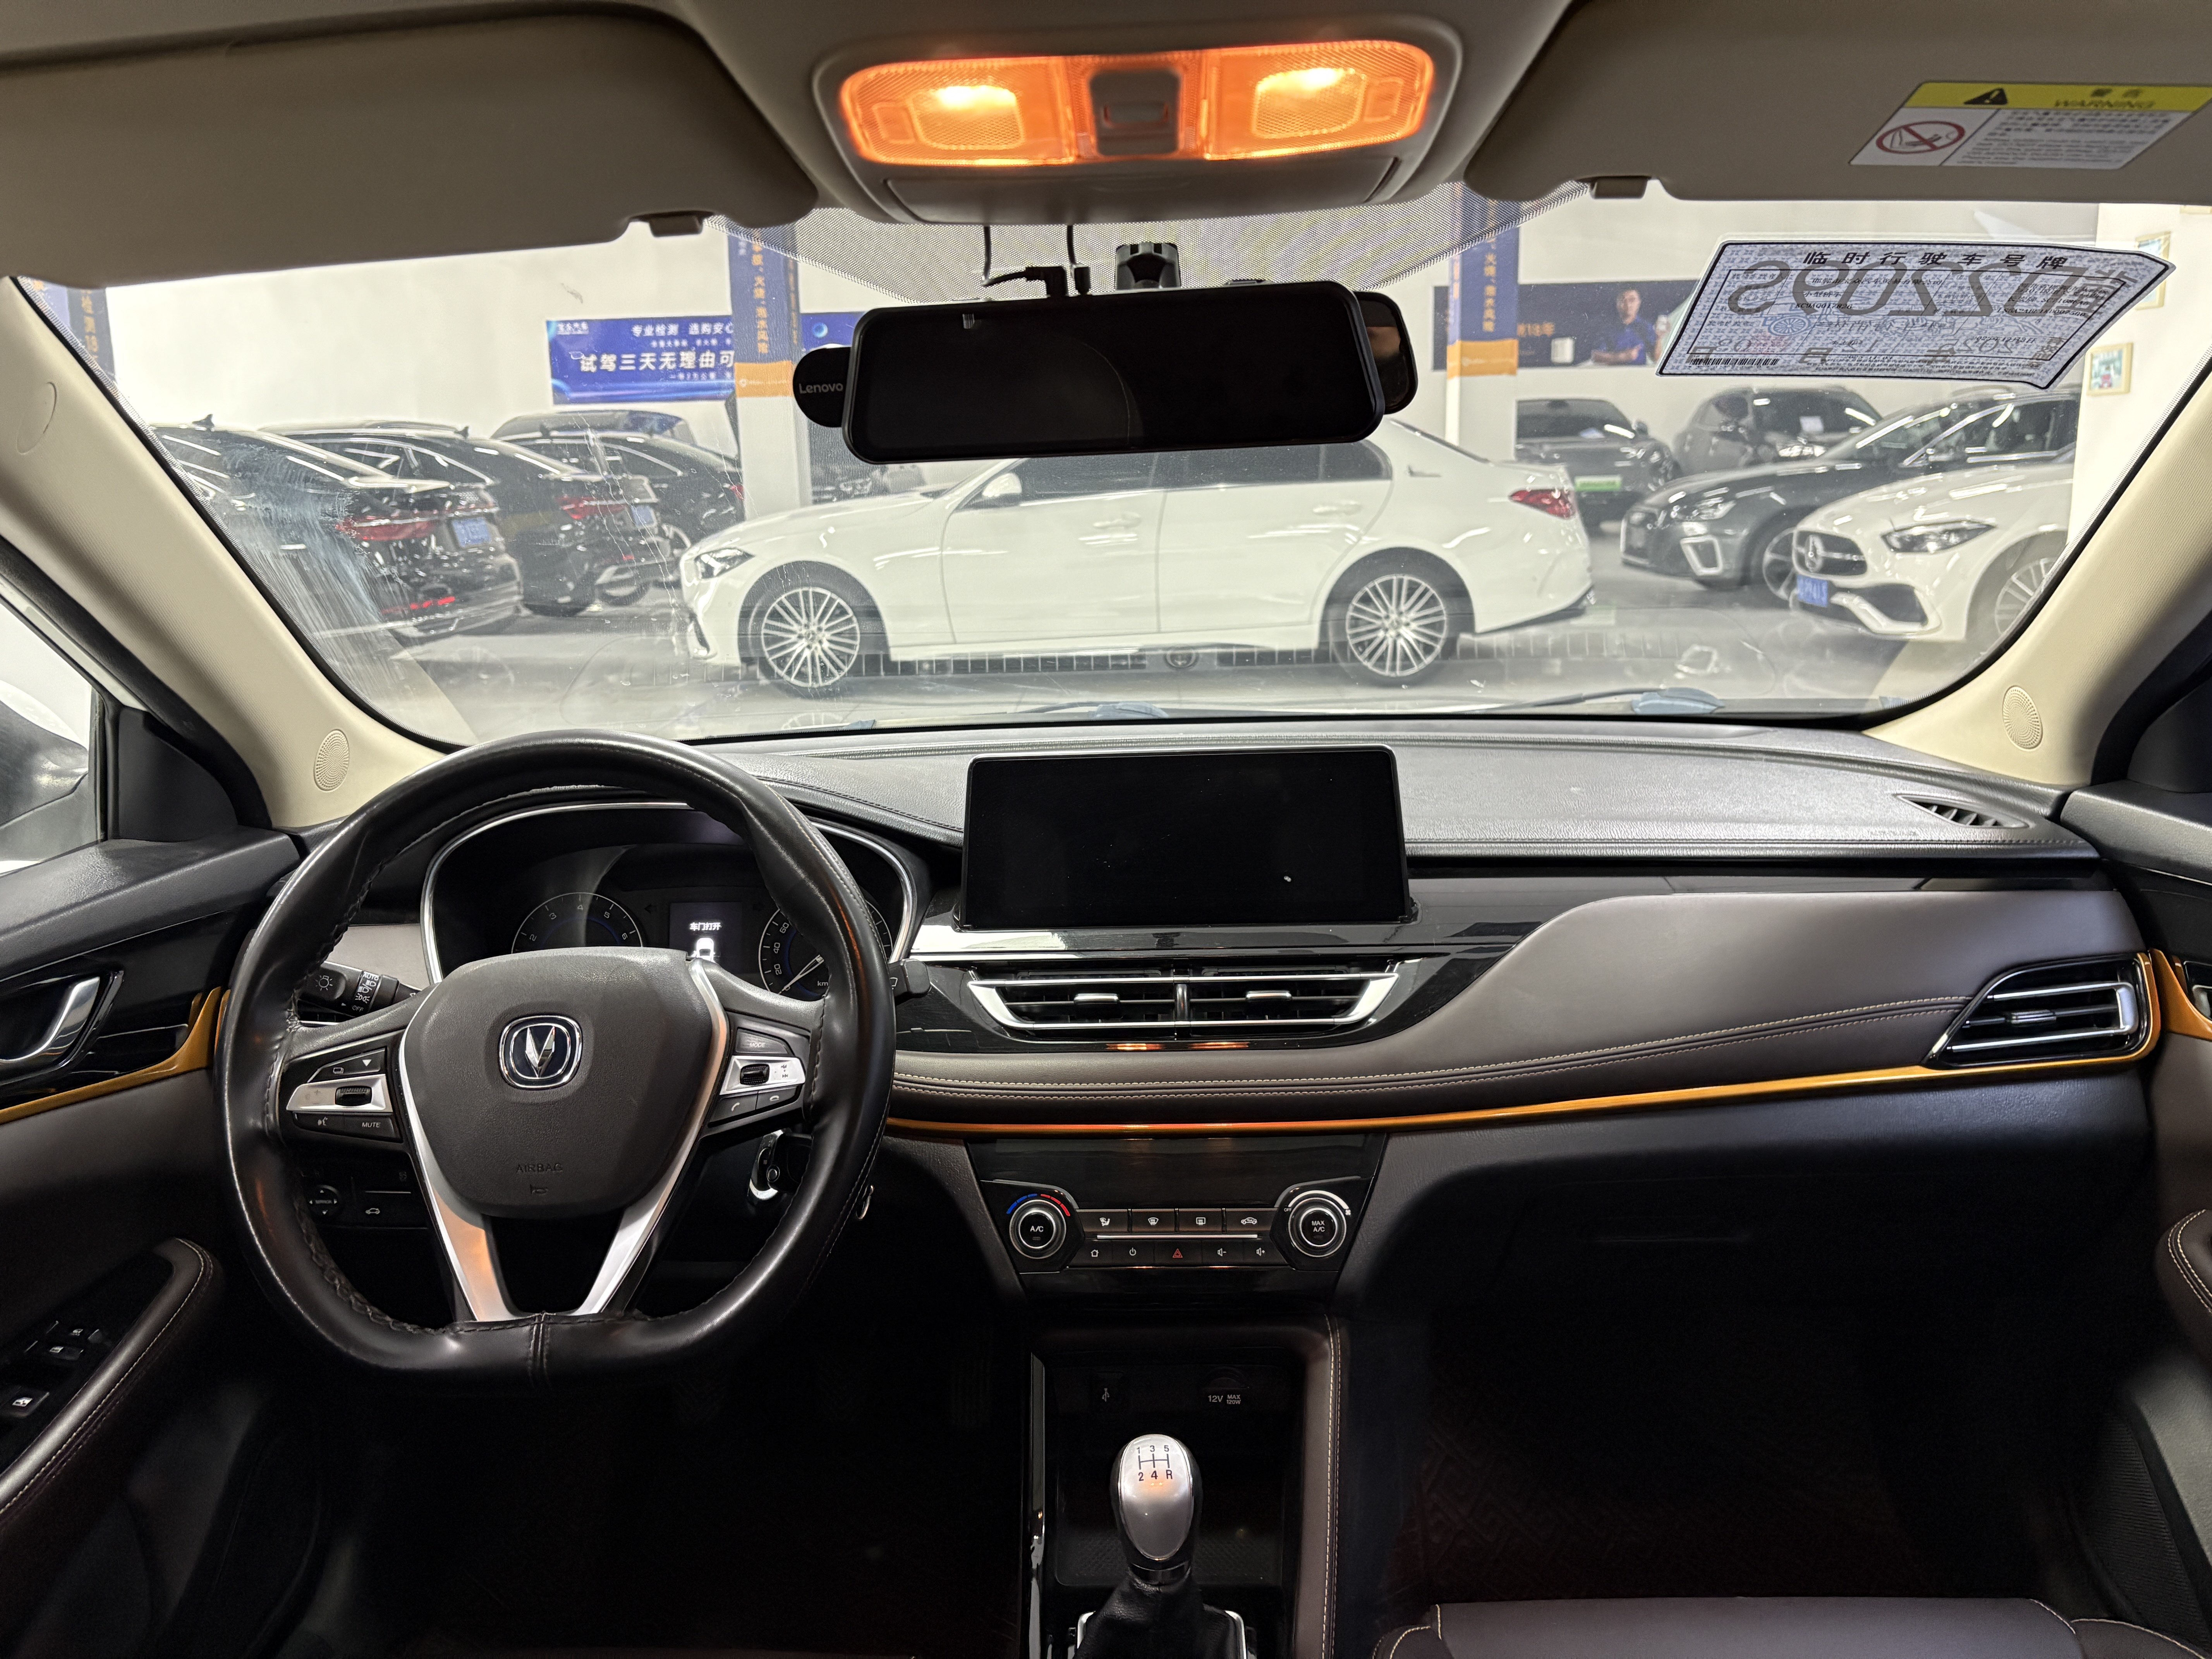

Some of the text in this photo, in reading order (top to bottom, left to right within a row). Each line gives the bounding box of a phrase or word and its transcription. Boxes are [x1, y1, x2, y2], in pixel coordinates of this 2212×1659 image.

[1802, 251, 2068, 270] 临时行驶车号牌
[632, 323, 679, 337] 专业检测
[580, 350, 735, 373] 试驾三天无理由可
[799, 383, 843, 394] Lenovo
[548, 912, 557, 920] 3
[690, 922, 721, 931] 车门打开
[779, 922, 790, 934] 60
[529, 933, 537, 942] 2
[622, 932, 628, 940] 6
[773, 942, 780, 953] 40
[774, 963, 782, 975] 20
[363, 972, 380, 981] AUTO
[516, 1163, 563, 1173] AIRBAG
[1138, 1469, 1173, 1482] 2 4 R
